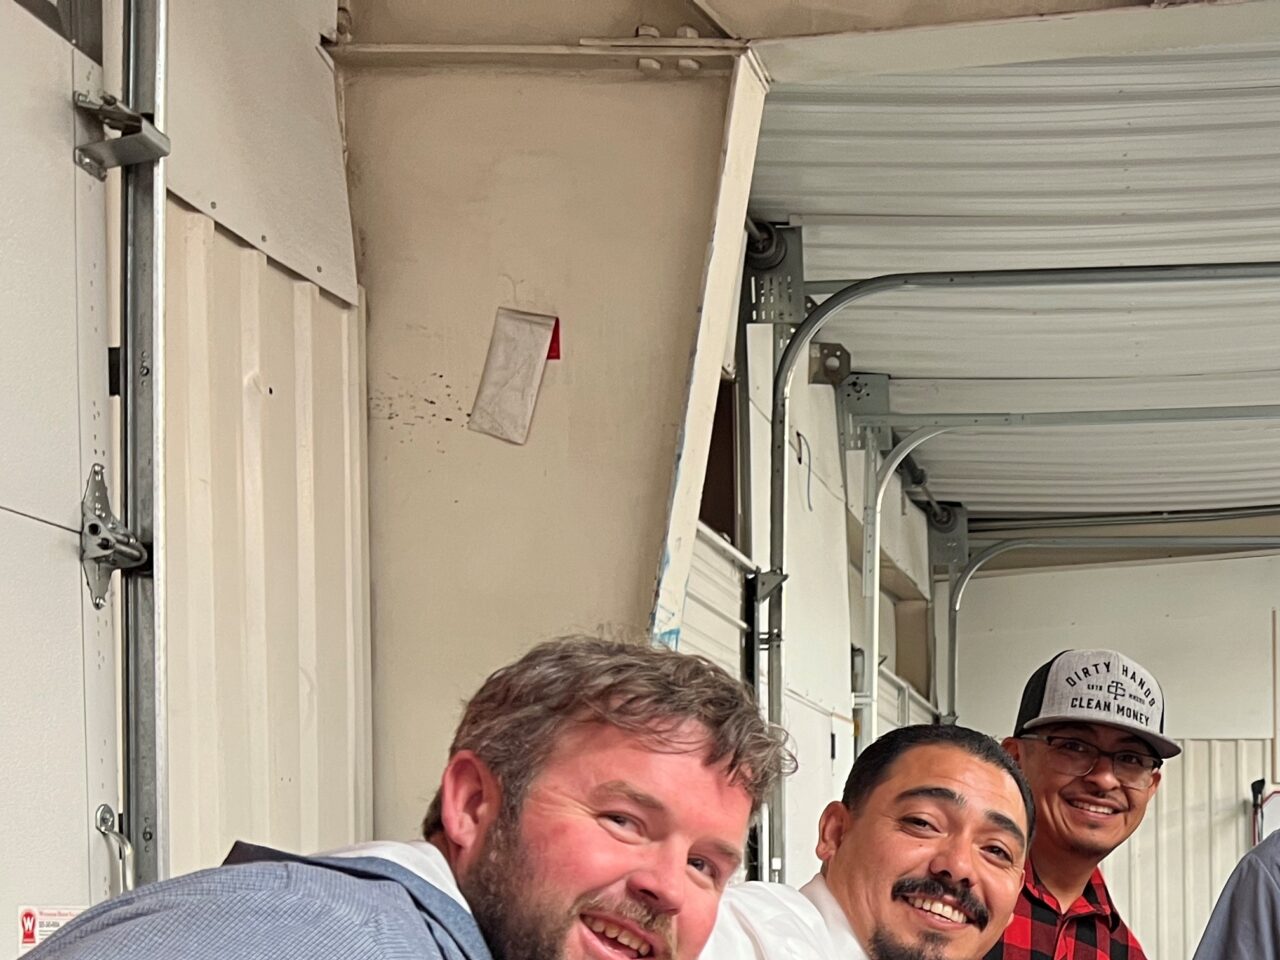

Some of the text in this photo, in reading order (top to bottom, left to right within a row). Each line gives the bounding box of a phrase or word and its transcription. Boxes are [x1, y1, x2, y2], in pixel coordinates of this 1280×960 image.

[1065, 661, 1156, 707] DIRTY HANDS
[1070, 697, 1111, 712] CLEAN
[1116, 704, 1150, 727] MONEY
